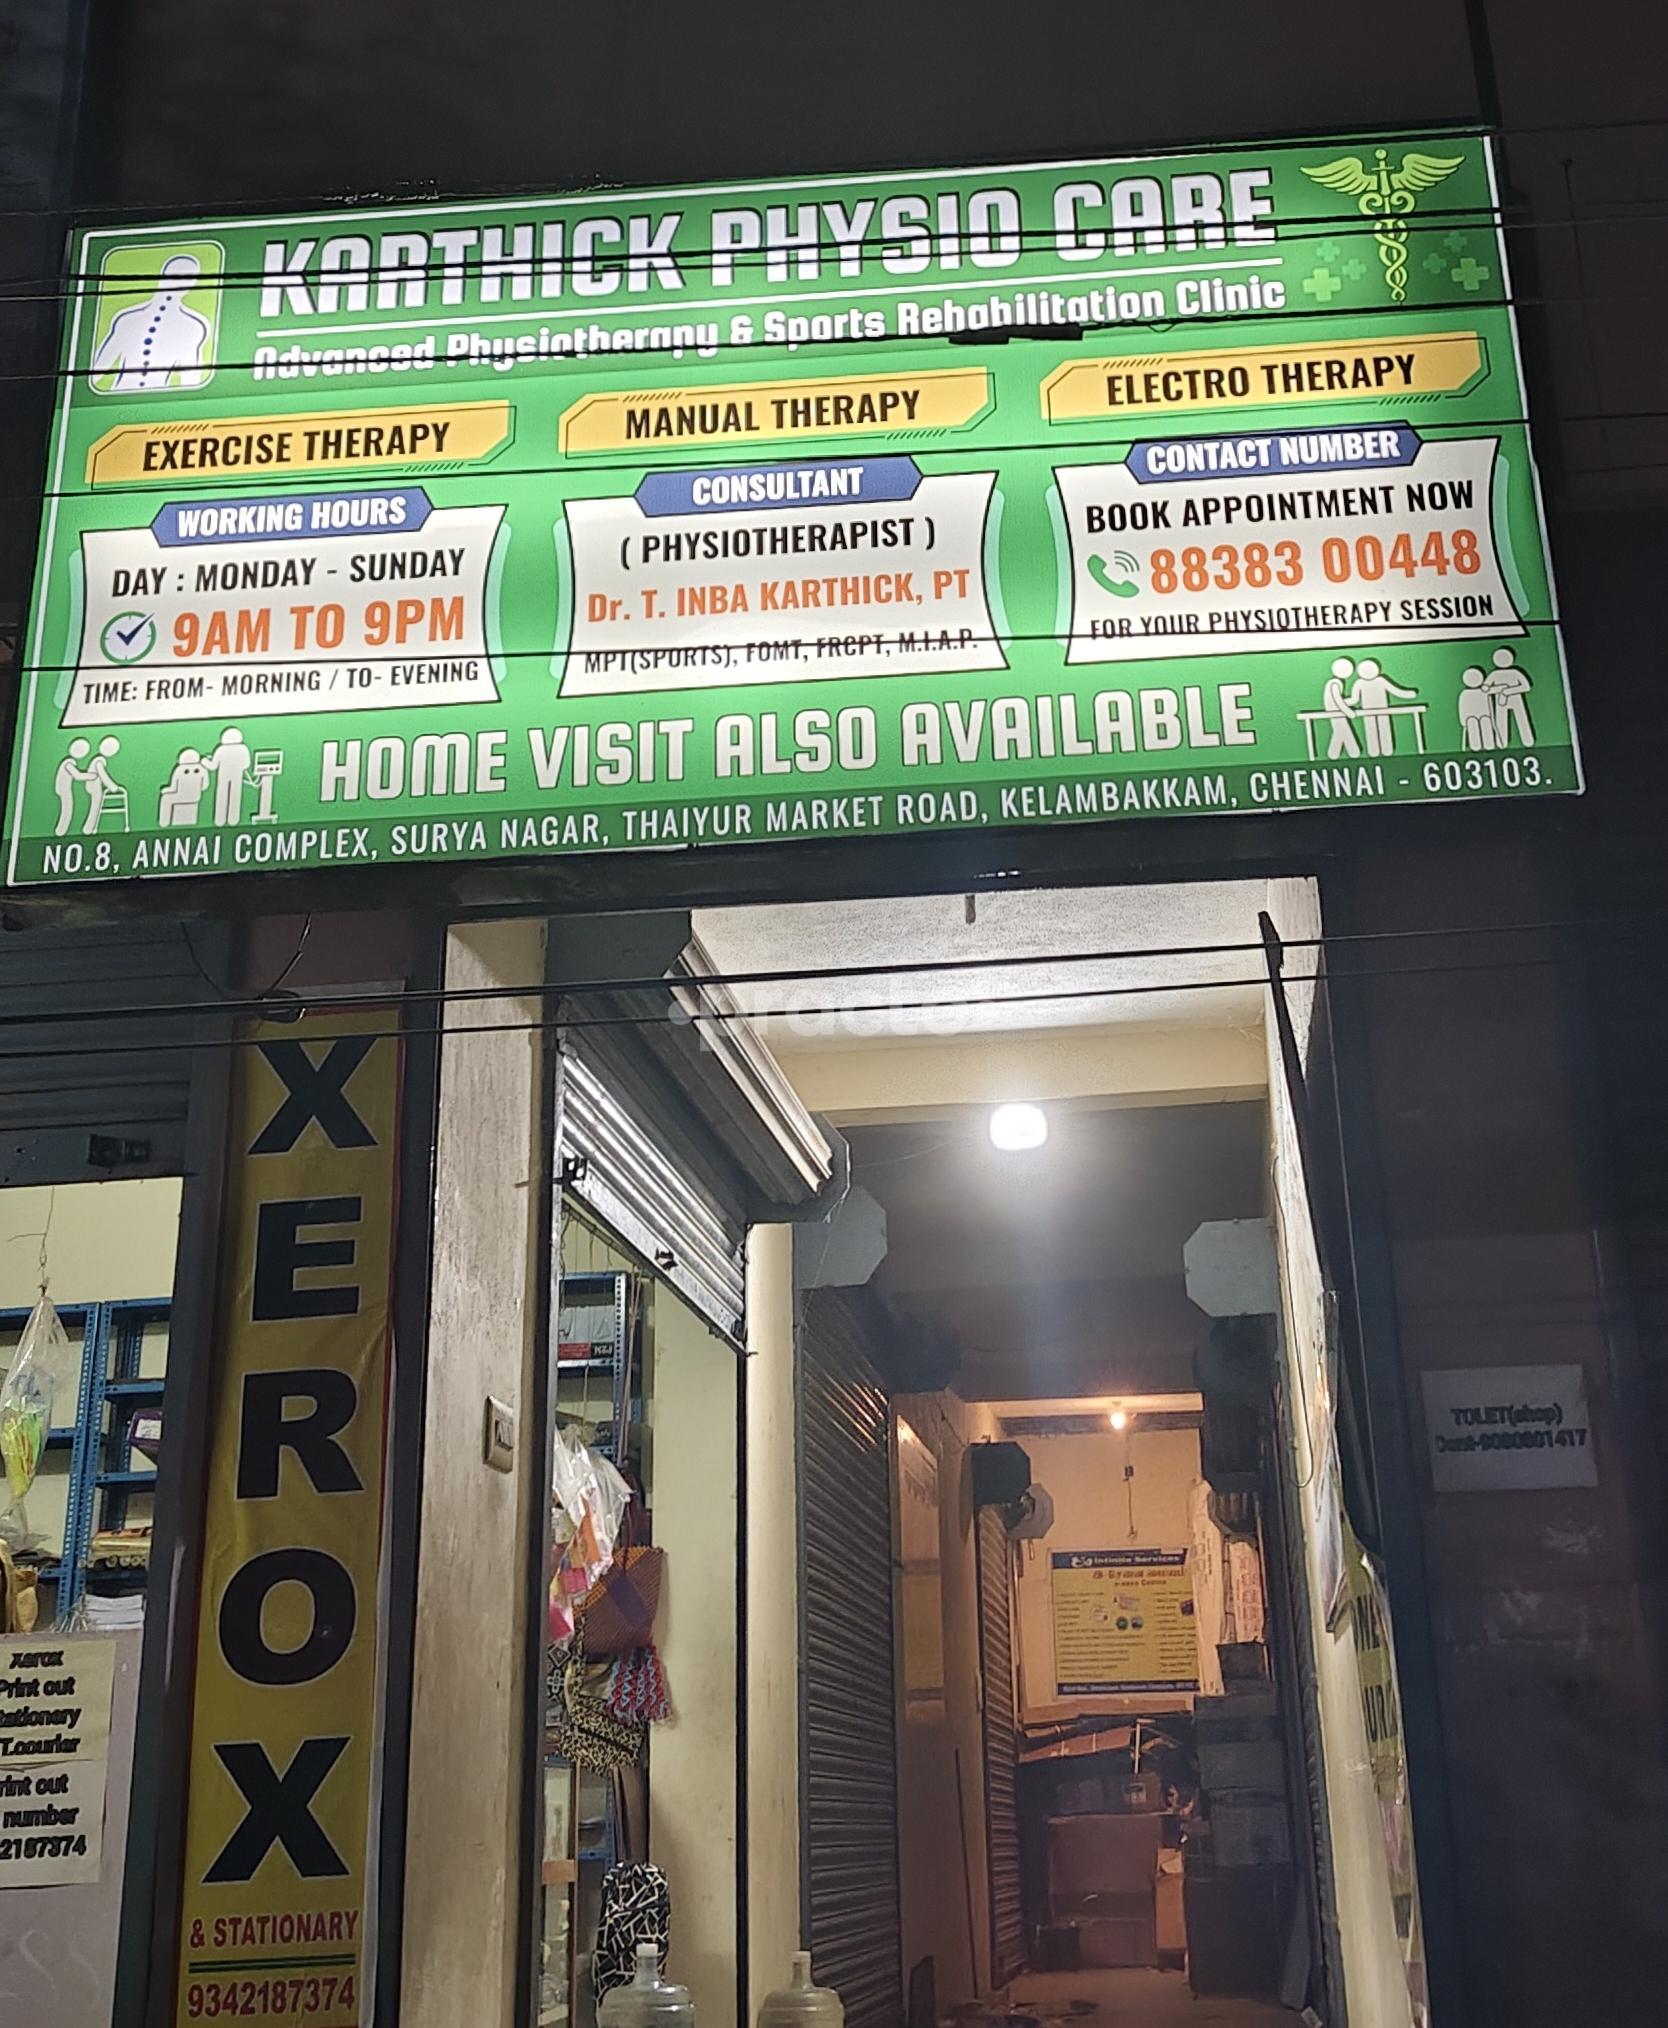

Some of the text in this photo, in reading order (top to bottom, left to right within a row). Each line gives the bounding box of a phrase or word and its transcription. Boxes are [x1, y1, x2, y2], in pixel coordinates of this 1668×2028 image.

[260, 168, 1279, 318] KARTHICK PHYSIO CARE
[253, 274, 1287, 382] Advanced Physiotherapy & Sports Rehabilitation Clinic
[1107, 354, 1416, 407] ELECTRO THERAPY
[624, 388, 920, 441] MANUAL THERAPY
[142, 421, 452, 473] EXERCISE THERAPY
[1145, 430, 1401, 475] CONTACT NUMBER
[691, 466, 864, 507] CONSULTANT
[1085, 479, 1476, 534] BOOK APPOINTMENT NOW
[177, 495, 408, 539] WORKING HOURS
[641, 518, 915, 564] PHYSIOTHERAPIST
[111, 568, 166, 599] DAY
[195, 556, 317, 593] MONDAY
[348, 548, 467, 583] SUNDAY
[1149, 528, 1482, 596] 88383 00448
[588, 568, 971, 623] Dr. T. INBA KARTHICK, PT
[1088, 594, 1495, 643] FOR YOUR PHYSIOTHERAPY SESSION
[172, 596, 467, 658] 9AM TO 9PM
[82, 678, 139, 706] TIME:
[144, 674, 214, 701] FROM-
[220, 668, 321, 696] MORNING
[345, 664, 383, 691] TO-
[390, 659, 480, 686] EVENING
[317, 681, 1258, 803] HOME VISIT ALSO AVAILABLE
[42, 842, 122, 875] NO.8,
[132, 835, 222, 870] ANNAI
[234, 827, 382, 865] COMPLEX,
[390, 821, 488, 856] SURYA
[498, 812, 612, 851] NAGAR,
[622, 804, 753, 840] THAIYUR
[764, 794, 883, 832] MARKET
[896, 790, 990, 826] ROAD,
[1000, 776, 1239, 821] KELAMBAKKAM,
[1249, 766, 1385, 803] CHENNAI
[1422, 757, 1555, 793] 603103.
[201, 1034, 380, 1886] XEROX
[43, 1676, 75, 1696] out
[36, 1774, 69, 1796] out
[3, 1804, 79, 1829] number
[189, 1909, 360, 1949] & STATIONARY
[187, 1974, 356, 2018] 9342187374
